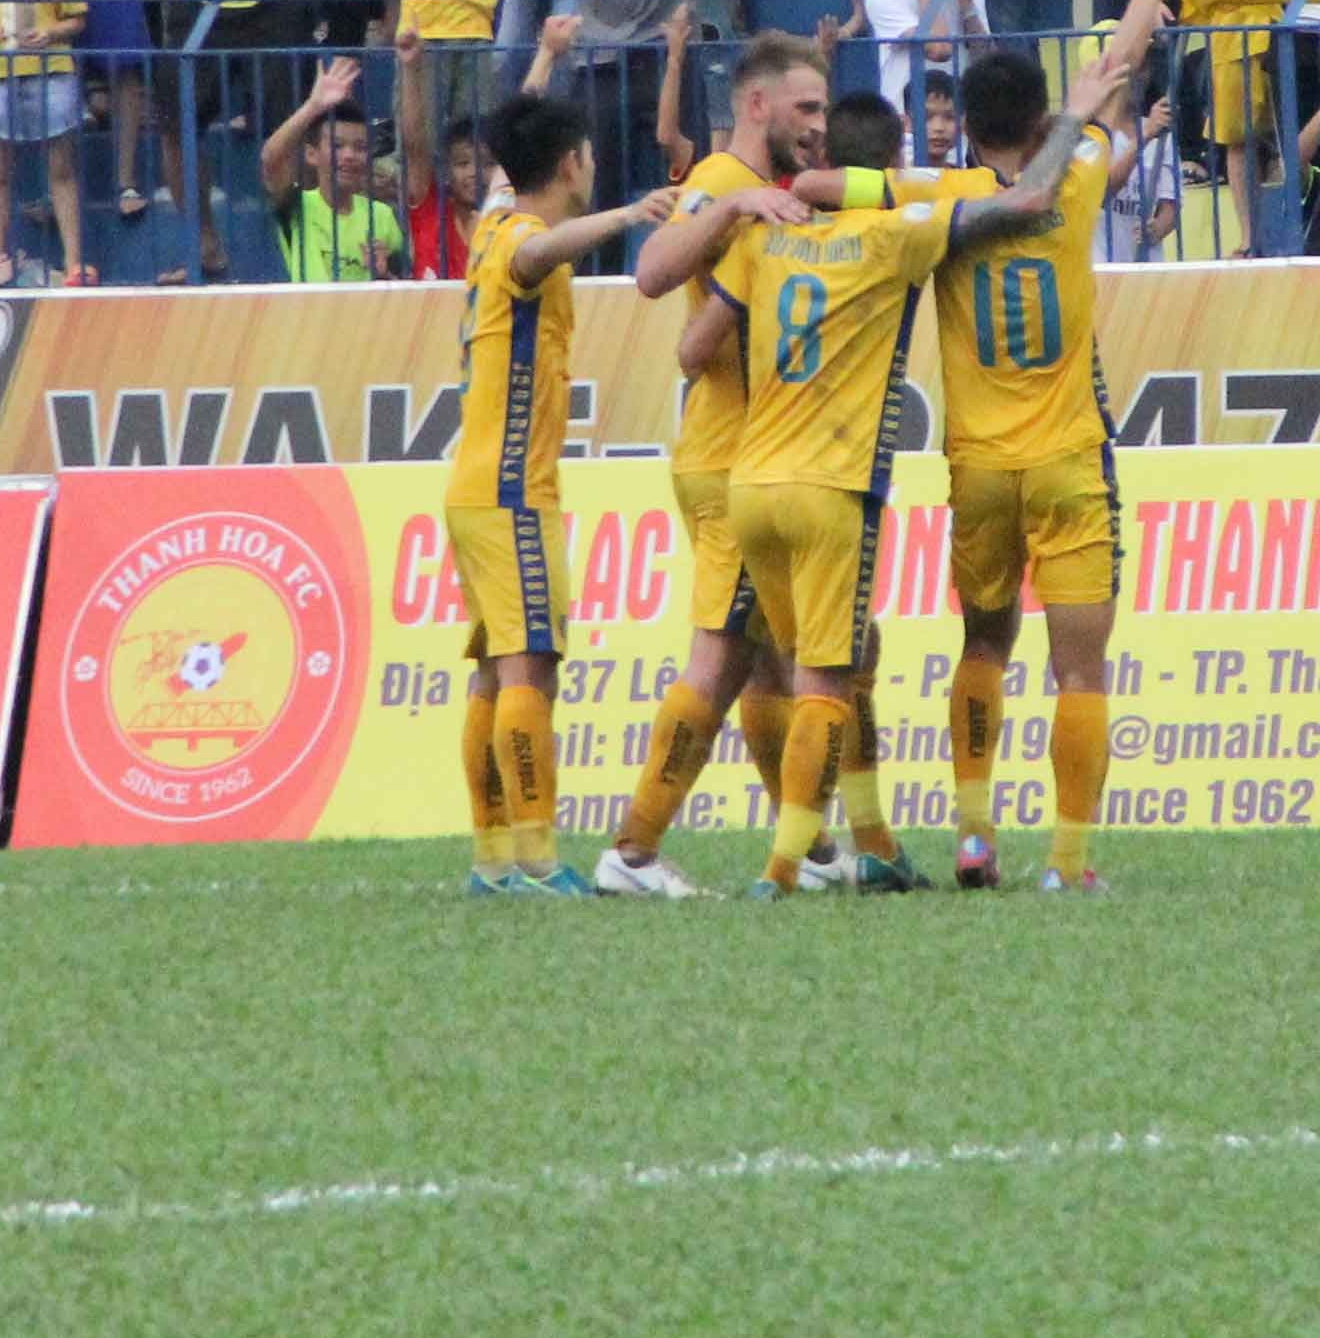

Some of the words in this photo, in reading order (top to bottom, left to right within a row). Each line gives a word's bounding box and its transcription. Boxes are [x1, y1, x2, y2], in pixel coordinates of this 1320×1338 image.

[776, 273, 828, 383] 8
[974, 257, 1063, 369] 10
[96, 528, 208, 615] THANH
[218, 524, 283, 568] HOA
[282, 562, 325, 610] FC
[381, 660, 451, 716] Địa
[562, 660, 616, 704] 37
[630, 658, 679, 702] Lê
[1192, 650, 1247, 695] TP.
[120, 767, 191, 806] SINCE
[198, 766, 253, 804] 1962
[991, 779, 1046, 825] FC
[1207, 779, 1315, 825] 1962
